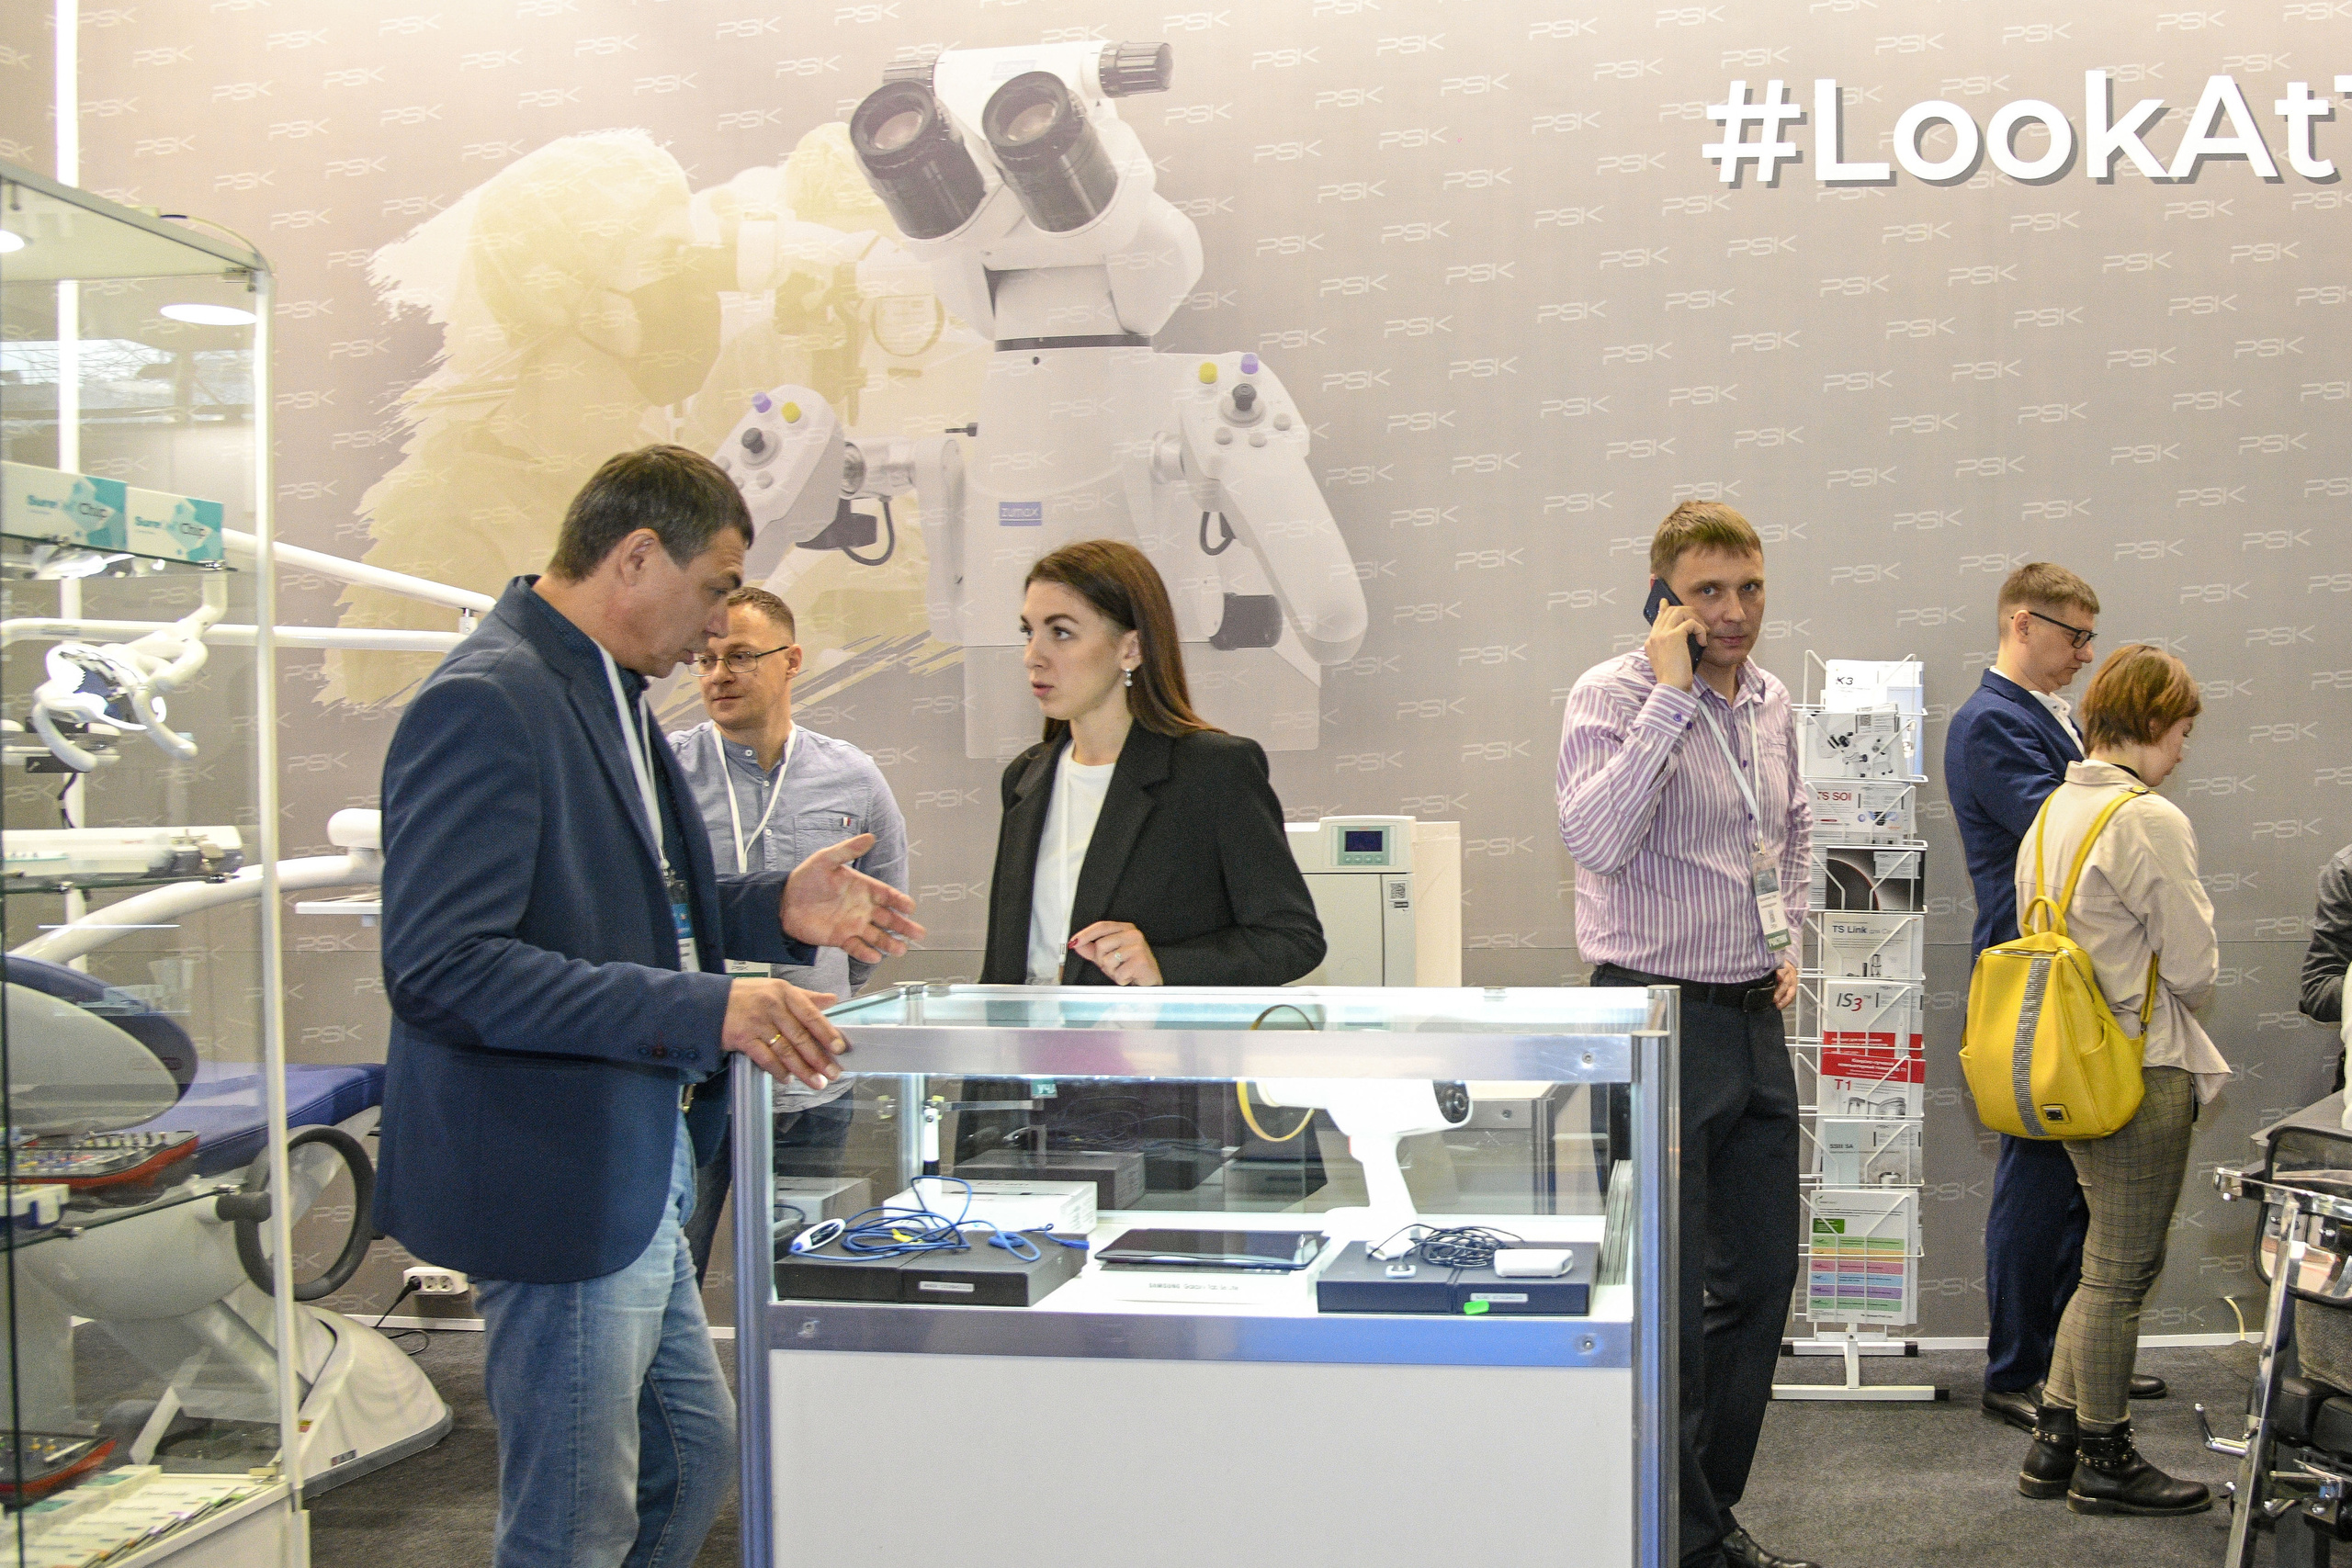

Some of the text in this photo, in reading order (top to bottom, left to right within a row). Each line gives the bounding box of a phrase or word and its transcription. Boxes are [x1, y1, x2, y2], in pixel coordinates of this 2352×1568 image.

[377, 14, 445, 38] PSK
[832, 2, 902, 26] PSK
[1162, 10, 1232, 34] PSK
[1656, 5, 1725, 28] PSK
[2155, 9, 2227, 33] PSK
[264, 28, 332, 51] PSK
[715, 17, 783, 40] PSK
[1529, 17, 1599, 41] PSK
[2003, 20, 2073, 46] PSK
[573, 34, 641, 58] PSK
[1376, 33, 1446, 57] PSK
[1874, 31, 1946, 57] PSK
[129, 45, 197, 69] PSK
[458, 49, 526, 73] PSK
[775, 55, 842, 79] PSK
[1251, 46, 1321, 70] PSK
[1721, 46, 1791, 70] PSK
[2222, 51, 2291, 75] PSK
[321, 66, 389, 90] PSK
[1594, 58, 1664, 82] PSK
[209, 80, 277, 104] PSK
[632, 73, 700, 96] PSK
[1441, 73, 1510, 96] PSK
[1940, 73, 2010, 97] PSK
[515, 86, 583, 110] PSK
[1315, 86, 1385, 110] PSK
[716, 107, 784, 131] PSK
[1164, 103, 1234, 127] PSK
[1532, 111, 1601, 135] PSK
[1378, 127, 1448, 151] PSK
[1253, 140, 1323, 164] PSK
[1597, 152, 1667, 175] PSK
[1443, 167, 1513, 191] PSK
[1317, 180, 1386, 204] PSK
[1534, 205, 1604, 229] PSK
[1662, 193, 1732, 217] PSK
[2165, 197, 2234, 222] PSK
[1381, 220, 1451, 244] PSK
[1882, 220, 1953, 246] PSK
[2010, 209, 2080, 235] PSK
[1256, 233, 1326, 257] PSK
[1727, 234, 1797, 258] PSK
[2229, 241, 2301, 265] PSK
[1600, 246, 1669, 270] PSK
[2102, 250, 2174, 276] PSK
[1446, 261, 1516, 285] PSK
[1948, 263, 2018, 288] PSK
[1319, 274, 1389, 298] PSK
[1819, 274, 1891, 298] PSK
[1666, 288, 1736, 311] PSK
[2168, 292, 2238, 318] PSK
[1537, 300, 1607, 324] PSK
[2014, 305, 2084, 331] PSK
[1384, 315, 1453, 339] PSK
[1885, 316, 1957, 340] PSK
[1258, 328, 1328, 352] PSK
[1731, 330, 1801, 354] PSK
[2234, 336, 2304, 360] PSK
[1603, 342, 1673, 366] PSK
[2106, 345, 2177, 371] PSK
[1322, 368, 1392, 392] PSK
[1449, 356, 1519, 380] PSK
[1951, 358, 2023, 382] PSK
[1823, 369, 1894, 393] PSK
[2301, 378, 2352, 402] PS
[1541, 395, 1611, 419] PSK
[1668, 383, 1738, 407] PSK
[2172, 388, 2244, 413] PSK
[1047, 396, 1117, 420] PSK
[2018, 400, 2087, 426] PSK
[1386, 410, 1456, 434] PSK
[1889, 412, 1961, 437] PSK
[1606, 437, 1676, 461] PSK
[1735, 425, 1804, 449] PSK
[2238, 432, 2308, 456] PSK
[988, 449, 1057, 473] PSK
[1452, 451, 1521, 475] PSK
[2109, 441, 2181, 467] PSK
[1326, 463, 1396, 487] PSK
[1826, 465, 1898, 491] PSK
[1955, 454, 2027, 479] PSK
[2176, 485, 2247, 509] PSK
[2302, 474, 2352, 500] PS
[1544, 491, 1614, 514] PSK
[2021, 498, 2091, 522] PSK
[1390, 505, 1460, 529] PSK
[1893, 507, 1964, 533] PSK
[2115, 538, 2185, 562] PSK
[2242, 527, 2312, 553] PSK
[1455, 547, 1525, 571] PSK
[1830, 562, 1902, 586] PSK
[1547, 587, 1617, 611] PSK
[2179, 581, 2251, 606] PSK
[1393, 601, 1463, 625] PSK
[1896, 604, 1966, 628] PSK
[2245, 625, 2315, 649] PSK
[1458, 643, 1528, 667] PSK
[1396, 696, 1466, 720] PSK
[2249, 720, 2319, 746] PSK
[1335, 750, 1405, 774] PSK
[1462, 739, 1532, 763] PSK
[913, 786, 983, 810] PSK
[2187, 773, 2256, 799] PSK
[2251, 818, 2323, 841] PSK
[1832, 925, 1844, 933] TS
[1847, 925, 1868, 933] Link
